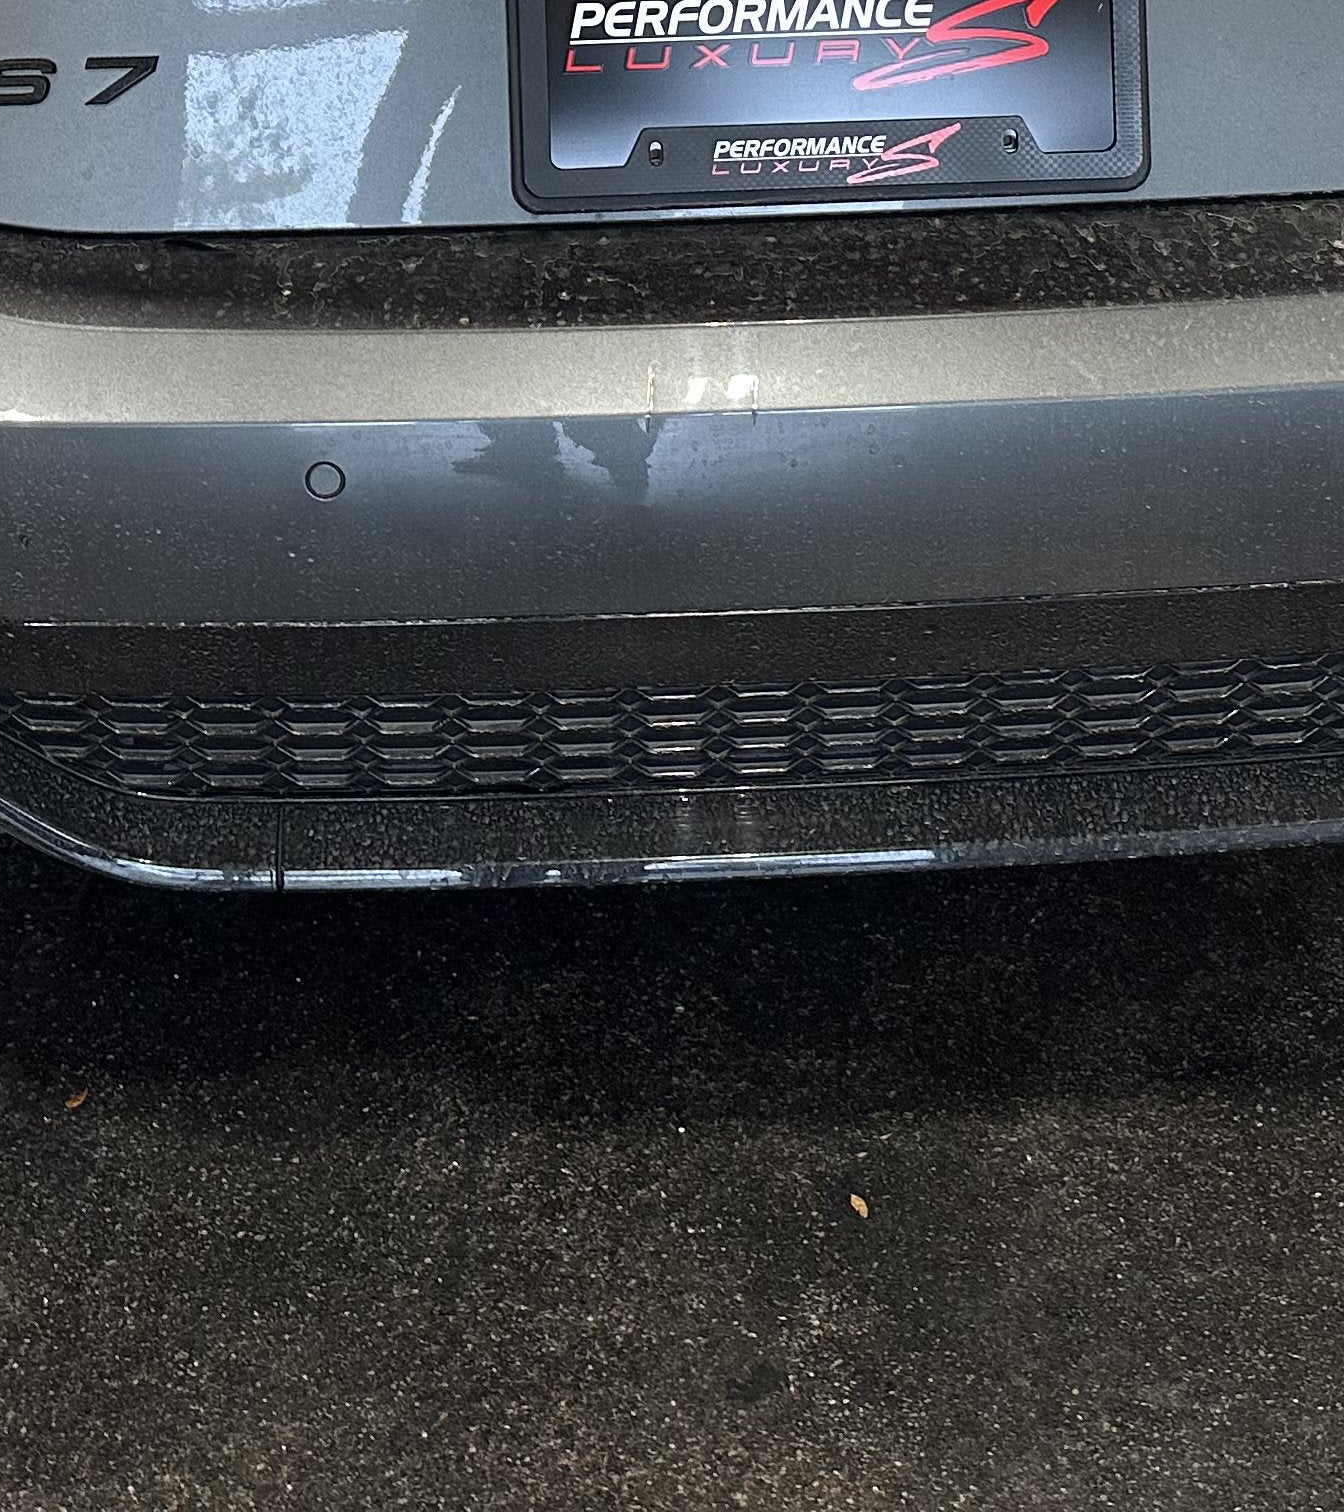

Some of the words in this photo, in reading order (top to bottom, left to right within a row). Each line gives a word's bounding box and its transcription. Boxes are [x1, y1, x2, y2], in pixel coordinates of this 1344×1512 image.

[563, 36, 924, 73] LUXURY
[84, 55, 160, 106] 7
[712, 134, 888, 159] PERFORMANCE
[711, 156, 881, 176] LUXURY
